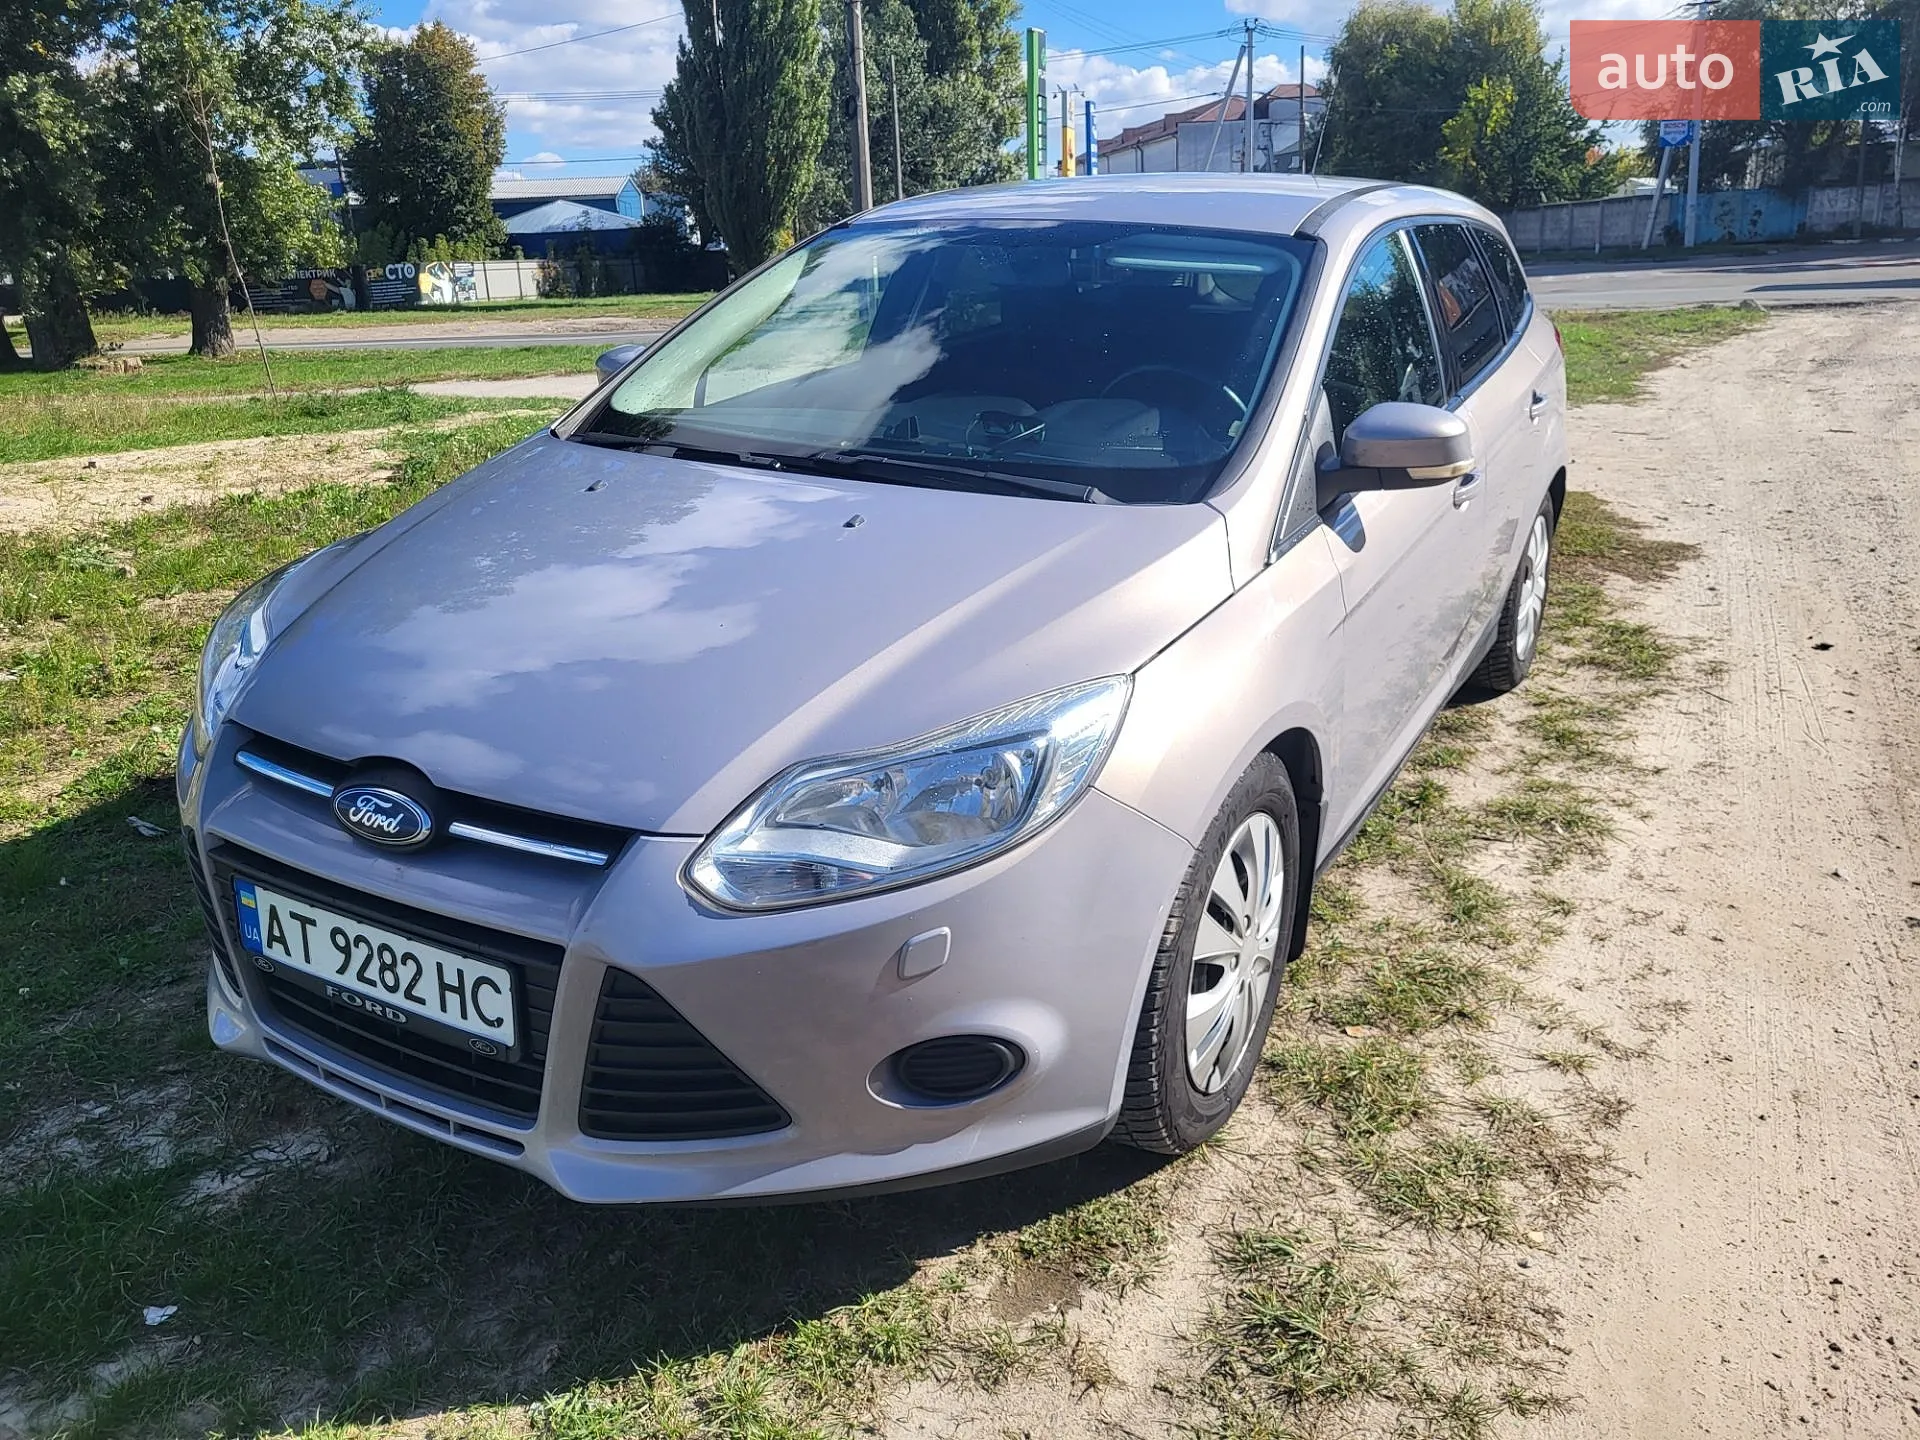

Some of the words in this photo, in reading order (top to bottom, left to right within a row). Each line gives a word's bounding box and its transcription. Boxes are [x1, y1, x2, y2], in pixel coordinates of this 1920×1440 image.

[385, 263, 415, 279] СТО
[349, 795, 404, 833] Ford
[245, 928, 260, 942] UA
[266, 903, 317, 965] AT
[329, 926, 427, 1006] 9282
[436, 961, 504, 1028] HC
[326, 985, 408, 1023] FORD
